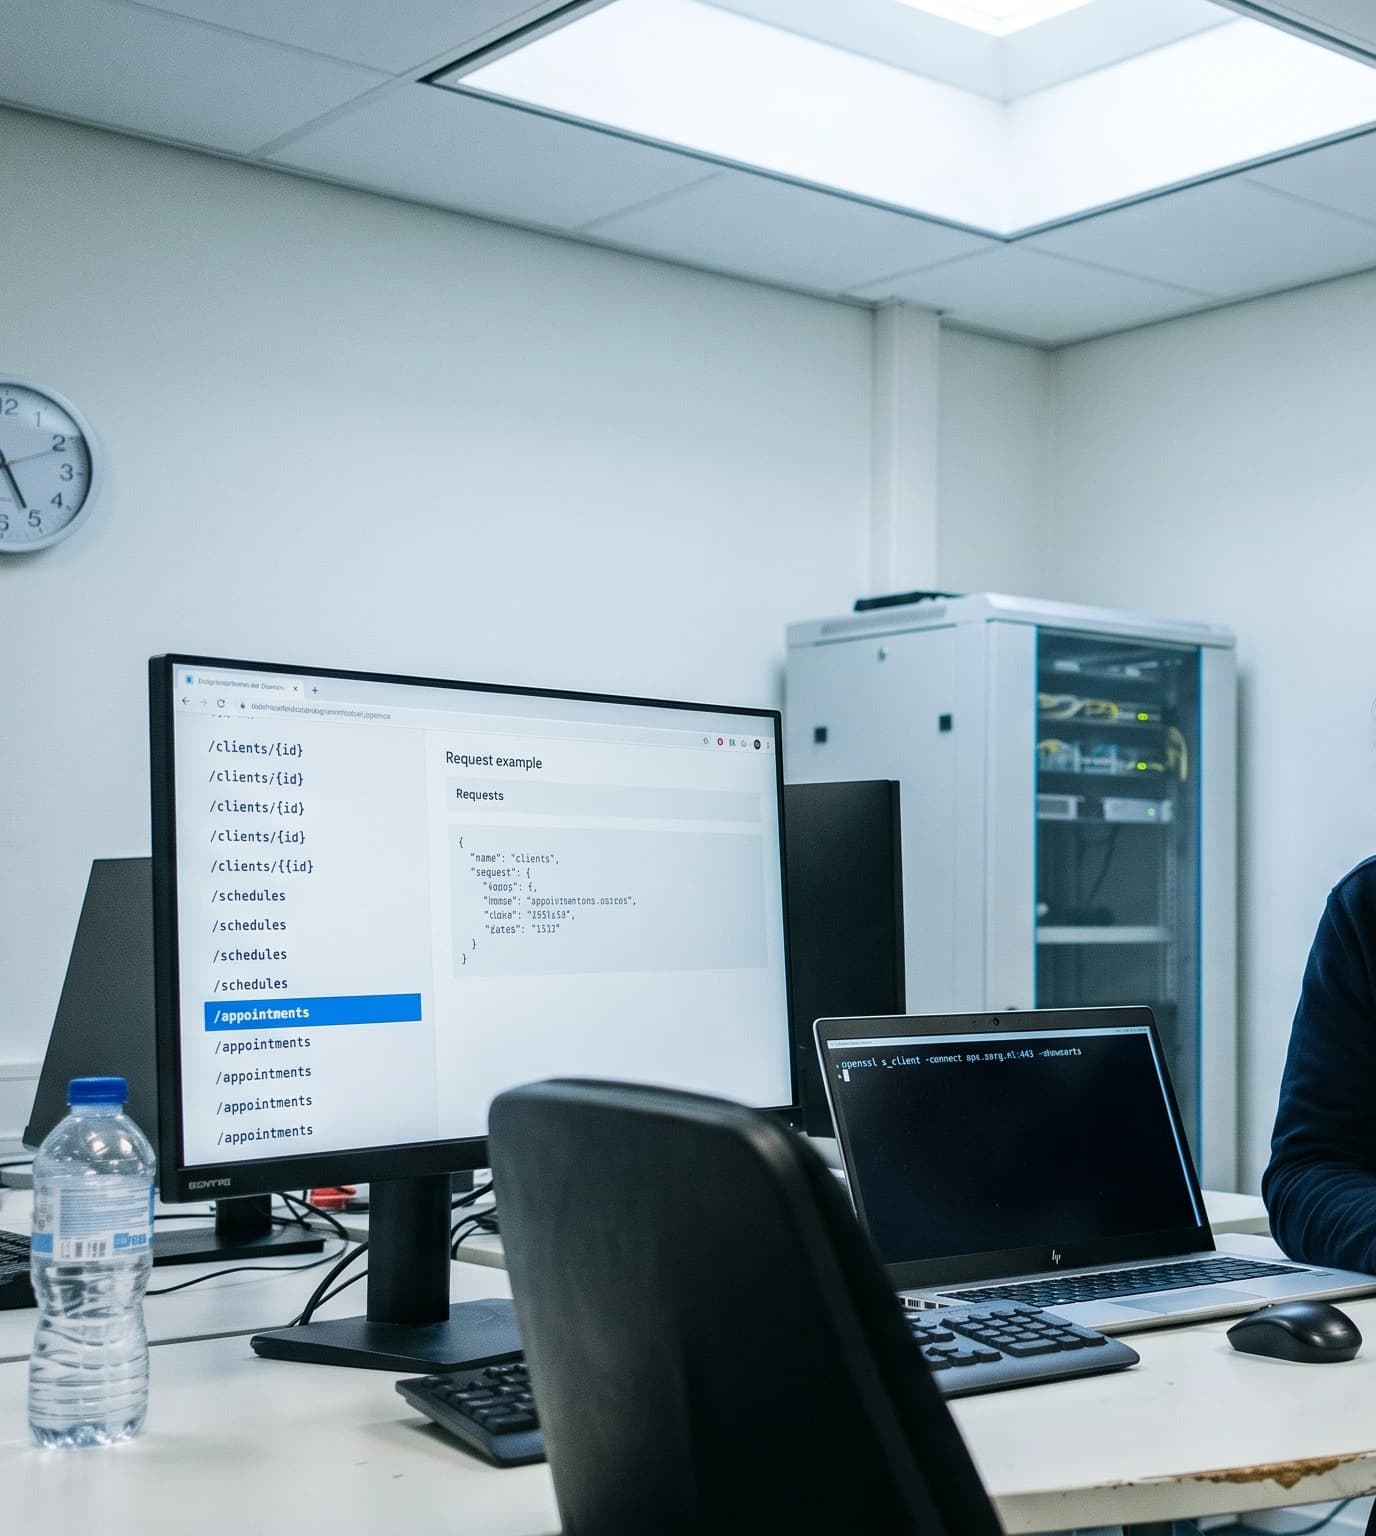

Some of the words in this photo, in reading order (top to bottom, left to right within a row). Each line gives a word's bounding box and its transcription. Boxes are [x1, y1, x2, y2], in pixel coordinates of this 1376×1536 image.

[52, 434, 66, 452] 2
[60, 463, 73, 481] 3
[50, 492, 63, 509] 4
[28, 509, 41, 527] 5
[209, 740, 302, 757] /clients/{id}
[446, 751, 493, 767] Request
[496, 757, 542, 771] example
[457, 789, 503, 802] Requests
[210, 800, 304, 816] /clients/{id}
[211, 830, 305, 844] /clients/{id}
[211, 860, 313, 873] /clients/{{id}
[212, 890, 285, 902] /schedules
[213, 919, 286, 932] /schedules
[214, 949, 286, 962] /schedules
[214, 978, 287, 992] /schedules
[214, 1008, 309, 1024] /appointments
[216, 1037, 310, 1054] /appointments
[842, 1058, 877, 1070] openssl
[882, 1056, 920, 1068] s_client
[216, 1067, 311, 1085] /appointments
[217, 1096, 312, 1115] /appointments
[218, 1126, 312, 1145] /appointments
